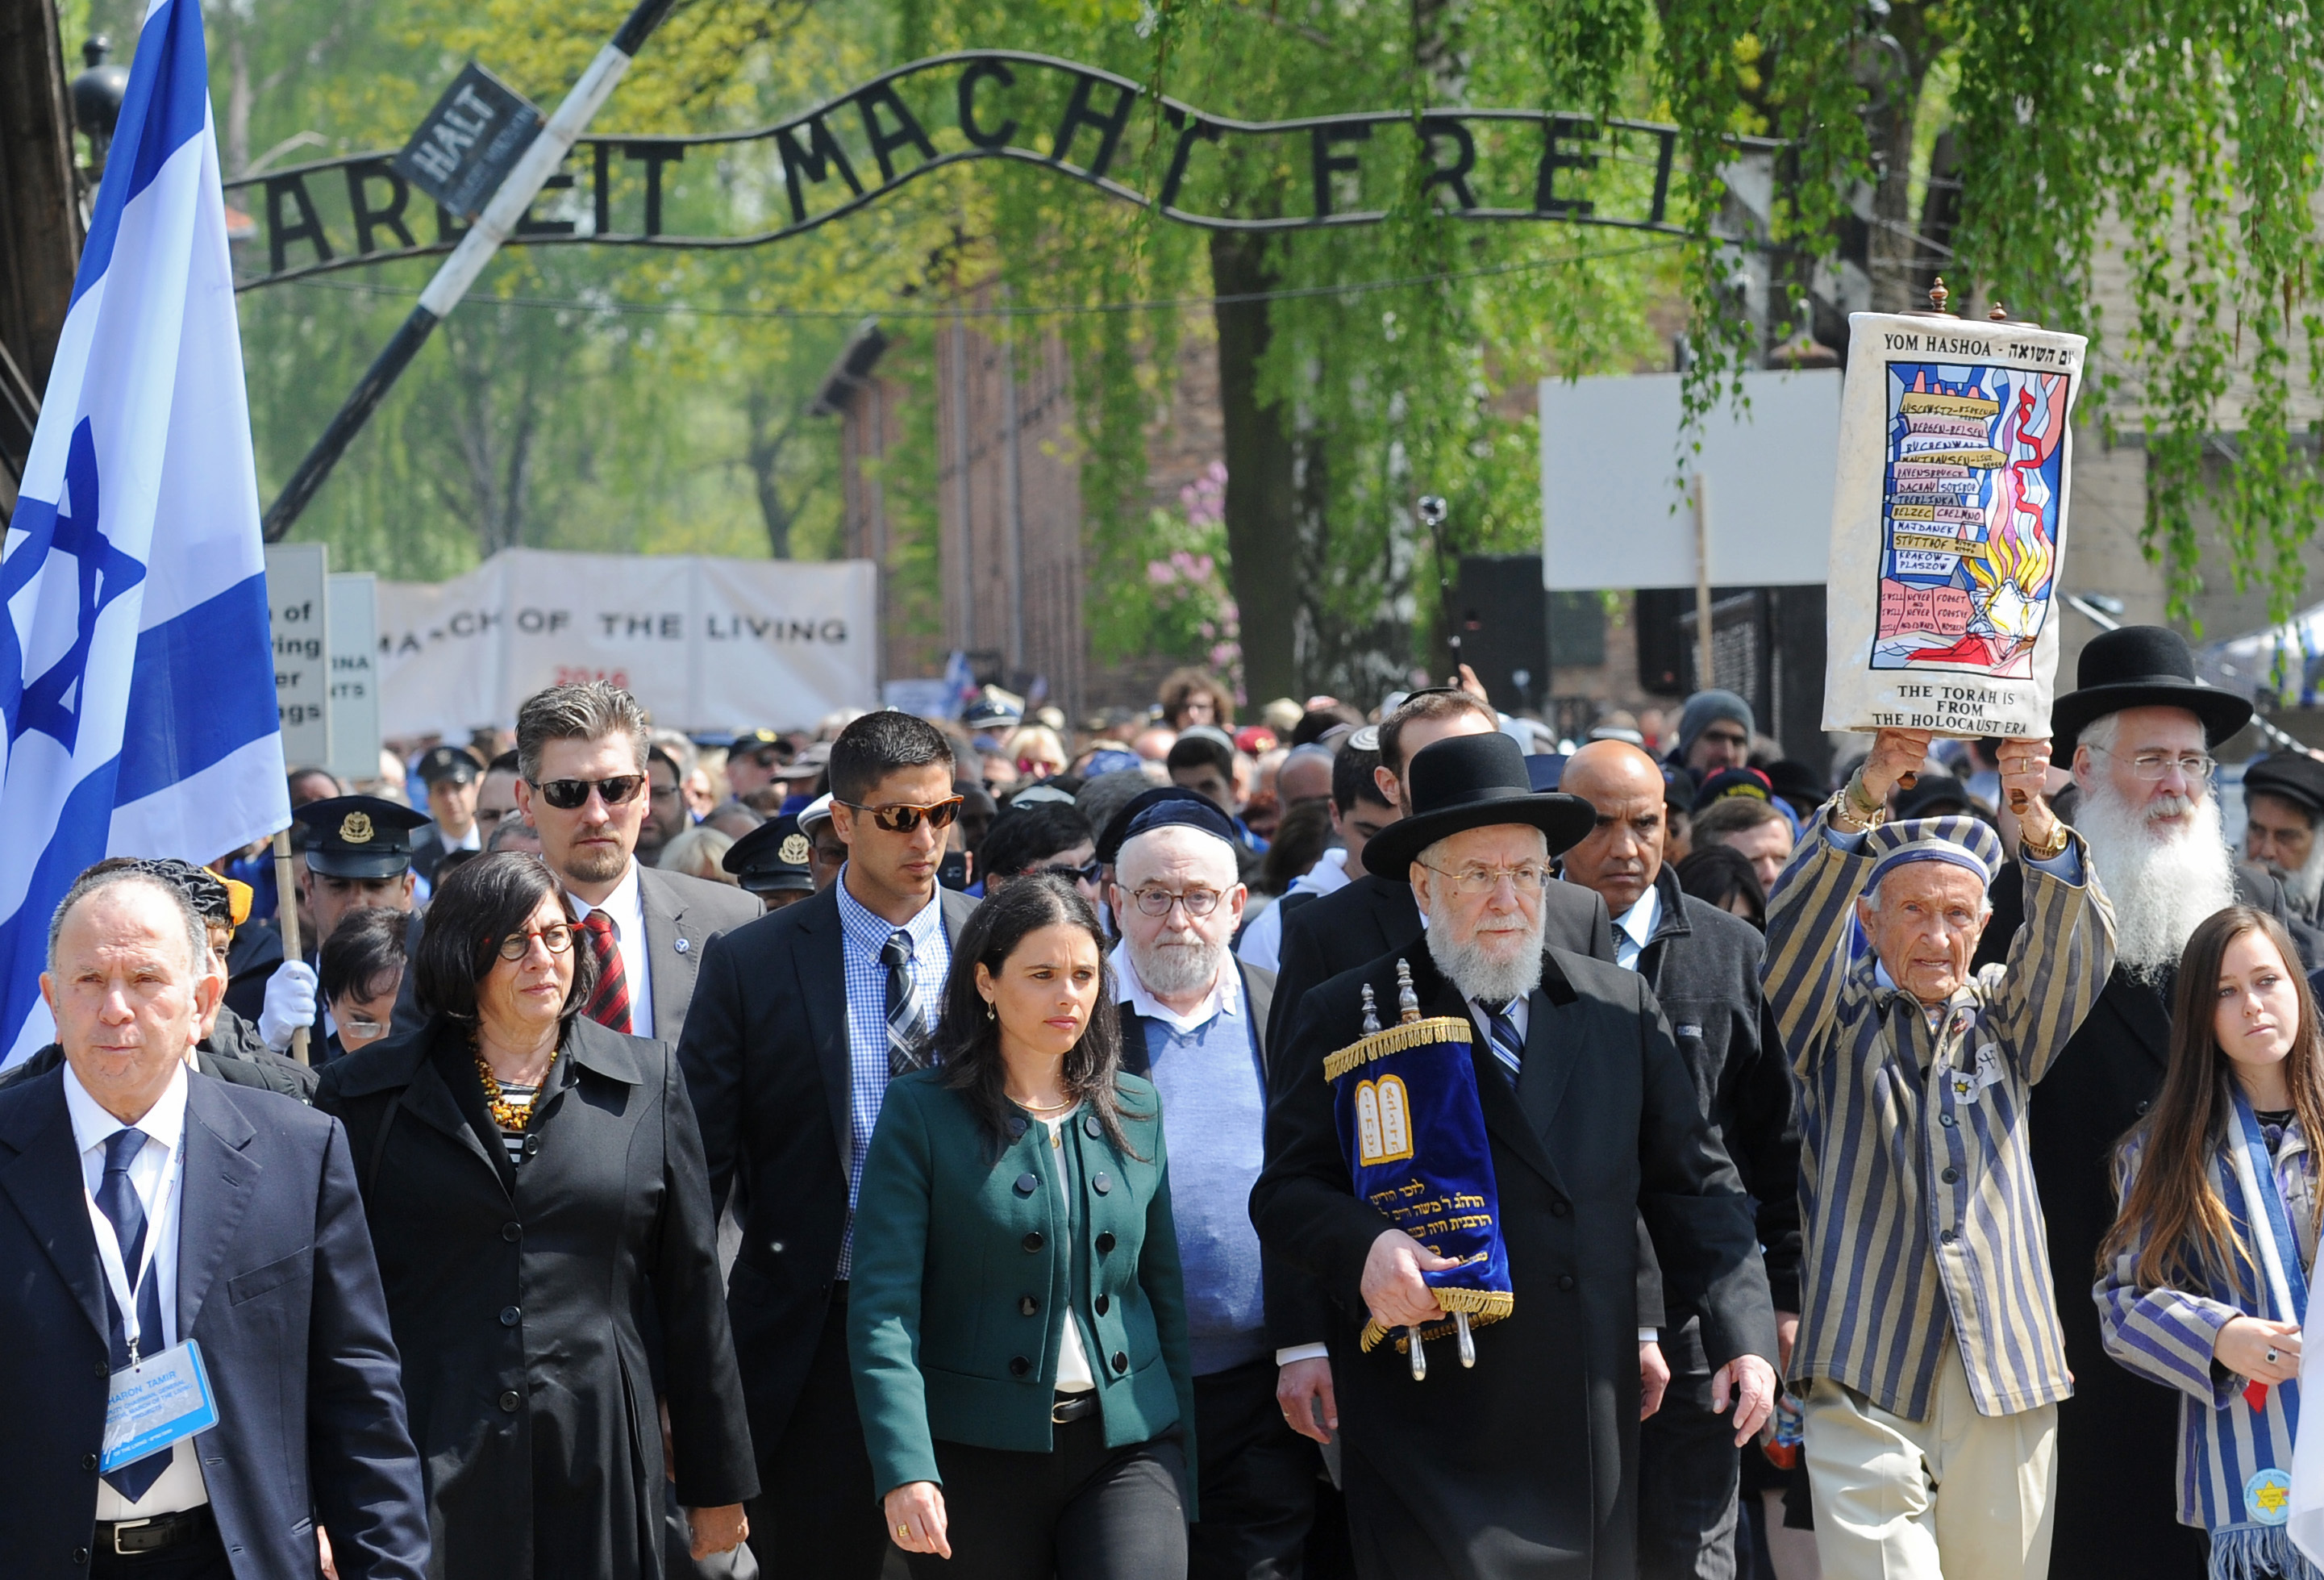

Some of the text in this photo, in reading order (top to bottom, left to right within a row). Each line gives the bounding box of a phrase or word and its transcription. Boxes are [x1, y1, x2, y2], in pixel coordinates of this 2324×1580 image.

[411, 82, 494, 183] HALT
[776, 56, 1222, 222] MACHT
[1311, 119, 1675, 223] FREI
[1885, 334, 1918, 350] YOM
[1926, 336, 1992, 356] HASHOA
[2009, 343, 2055, 362] השואה
[1912, 423, 1984, 437] BERGEN-BELSEN
[1905, 440, 1985, 453] BUCHENWALD
[1897, 468, 1964, 477] RAVENSBRUECK
[1900, 482, 1935, 492] DACHAU
[1897, 494, 1955, 506] TREBLINKA
[1893, 507, 1932, 518] BELZEC
[1937, 508, 1981, 520] CHELMNO
[1897, 521, 1954, 533] MAJDANEK
[1895, 536, 1949, 549] STUTTHOF
[1900, 561, 1947, 571] PLASZOW
[1907, 593, 1930, 602] NEVER
[1936, 594, 1967, 603] FORGET
[285, 600, 312, 622] of
[1906, 608, 1930, 617] NEVER
[1937, 609, 1968, 619] FORGIVE
[518, 607, 569, 633] OF
[599, 613, 683, 640] THE
[707, 618, 849, 644] LIVING
[1897, 686, 2014, 705] THE TORAH IS
[1937, 700, 1983, 716] FROM
[1872, 713, 2026, 735] THE HOLOCAUST ERA
[1398, 1178, 1425, 1197] לזכר
[1413, 1202, 1442, 1217] משה
[1427, 1220, 1448, 1235] חיה
[1449, 1215, 1492, 1232] הרבנית
[146, 1371, 176, 1388] TAMIR
